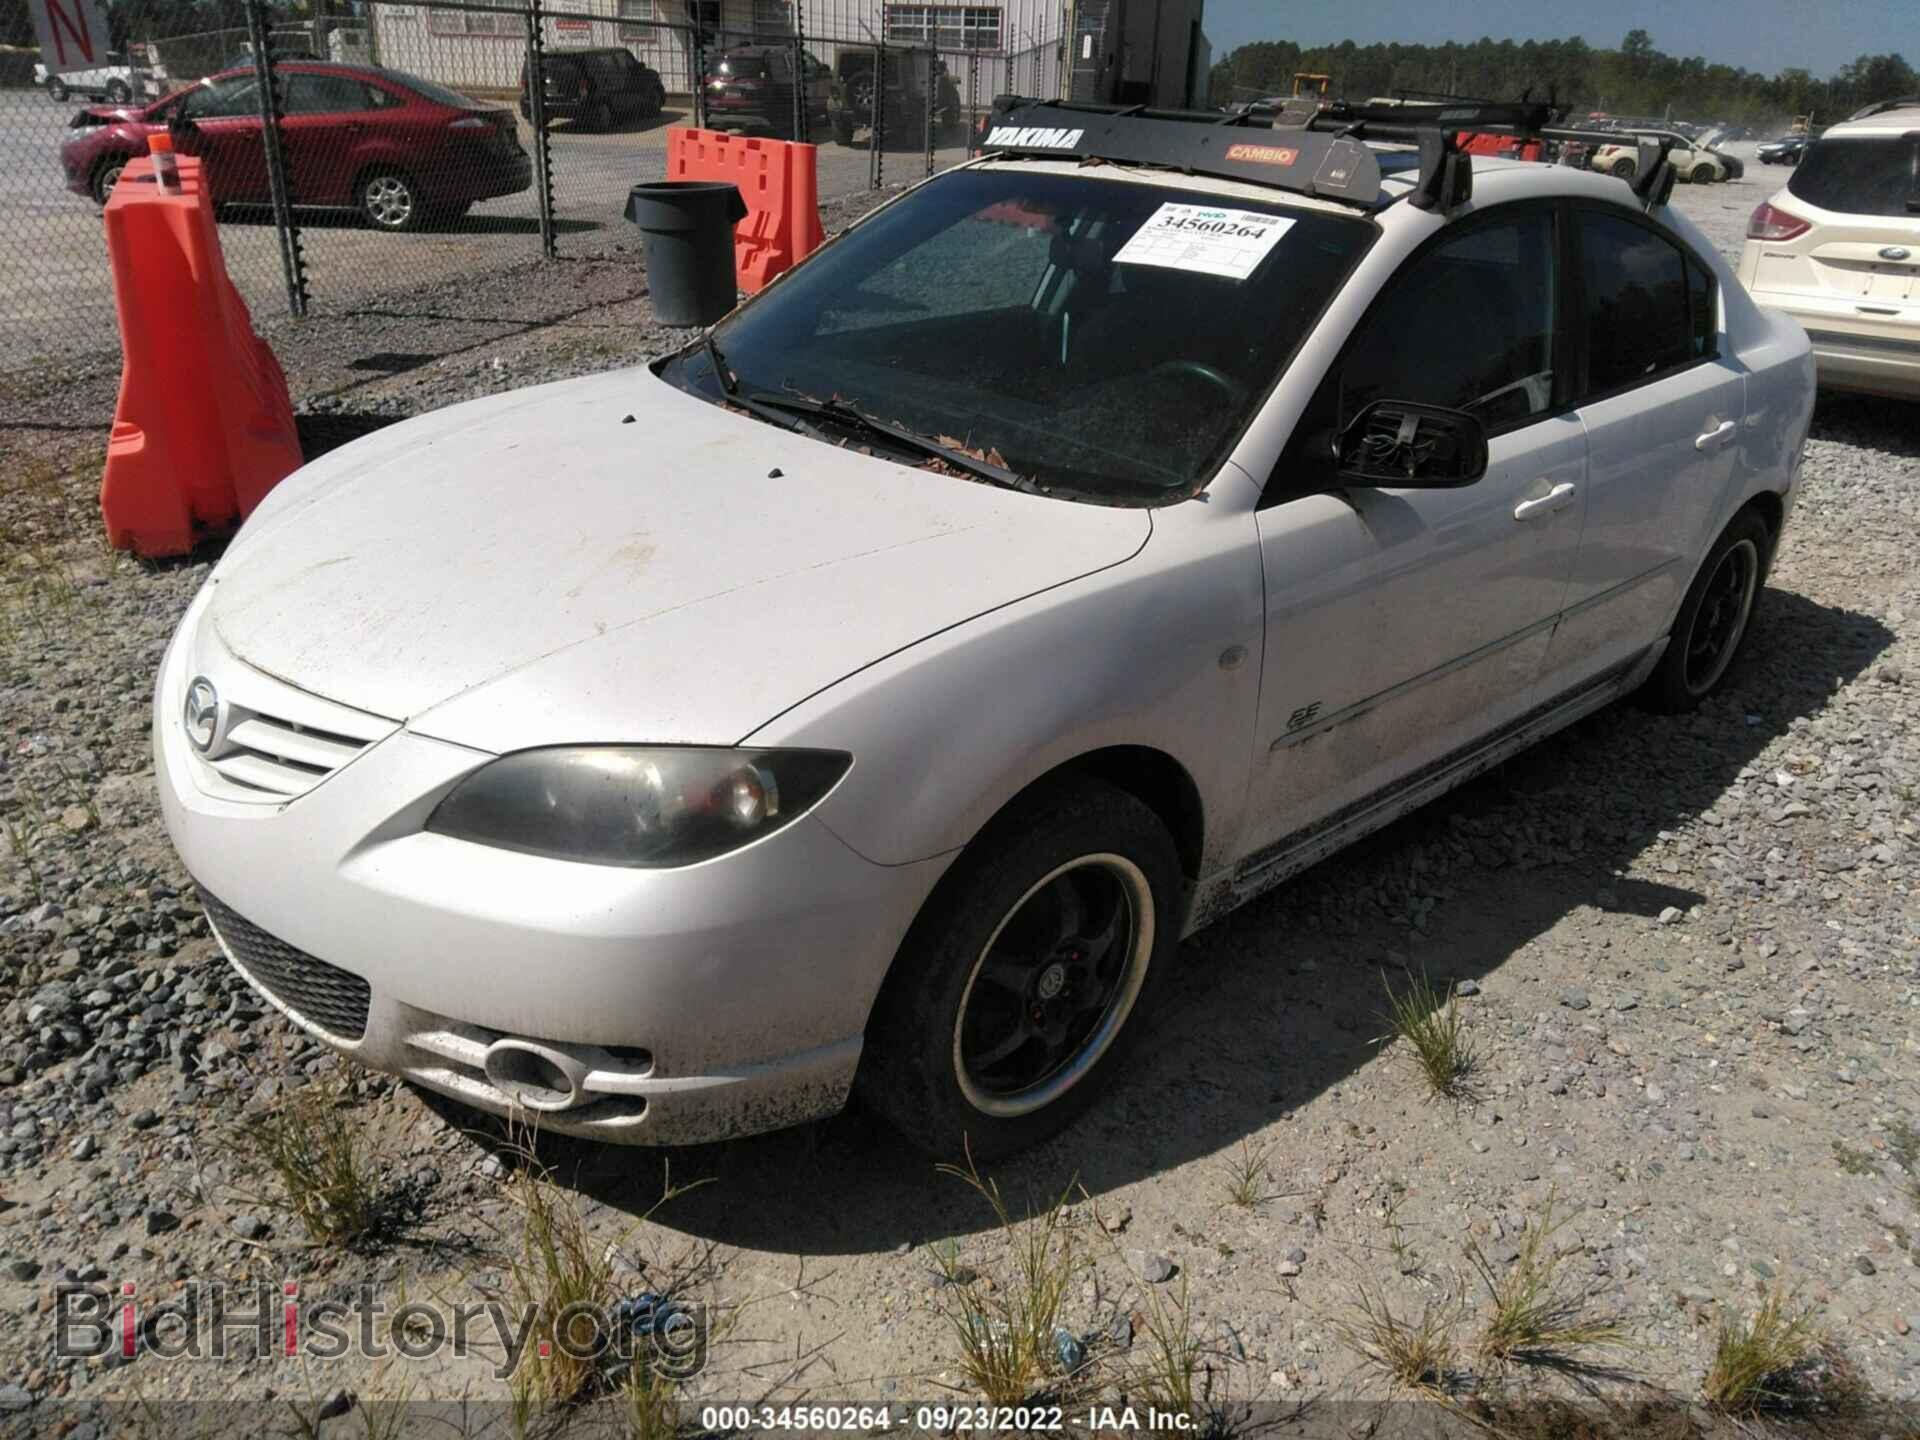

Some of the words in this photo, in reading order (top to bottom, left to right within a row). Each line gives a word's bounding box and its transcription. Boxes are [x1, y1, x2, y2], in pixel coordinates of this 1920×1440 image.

[984, 126, 1085, 149] YAKIMA
[1230, 145, 1292, 162] CAMBIO
[1157, 215, 1267, 240] 34560264
